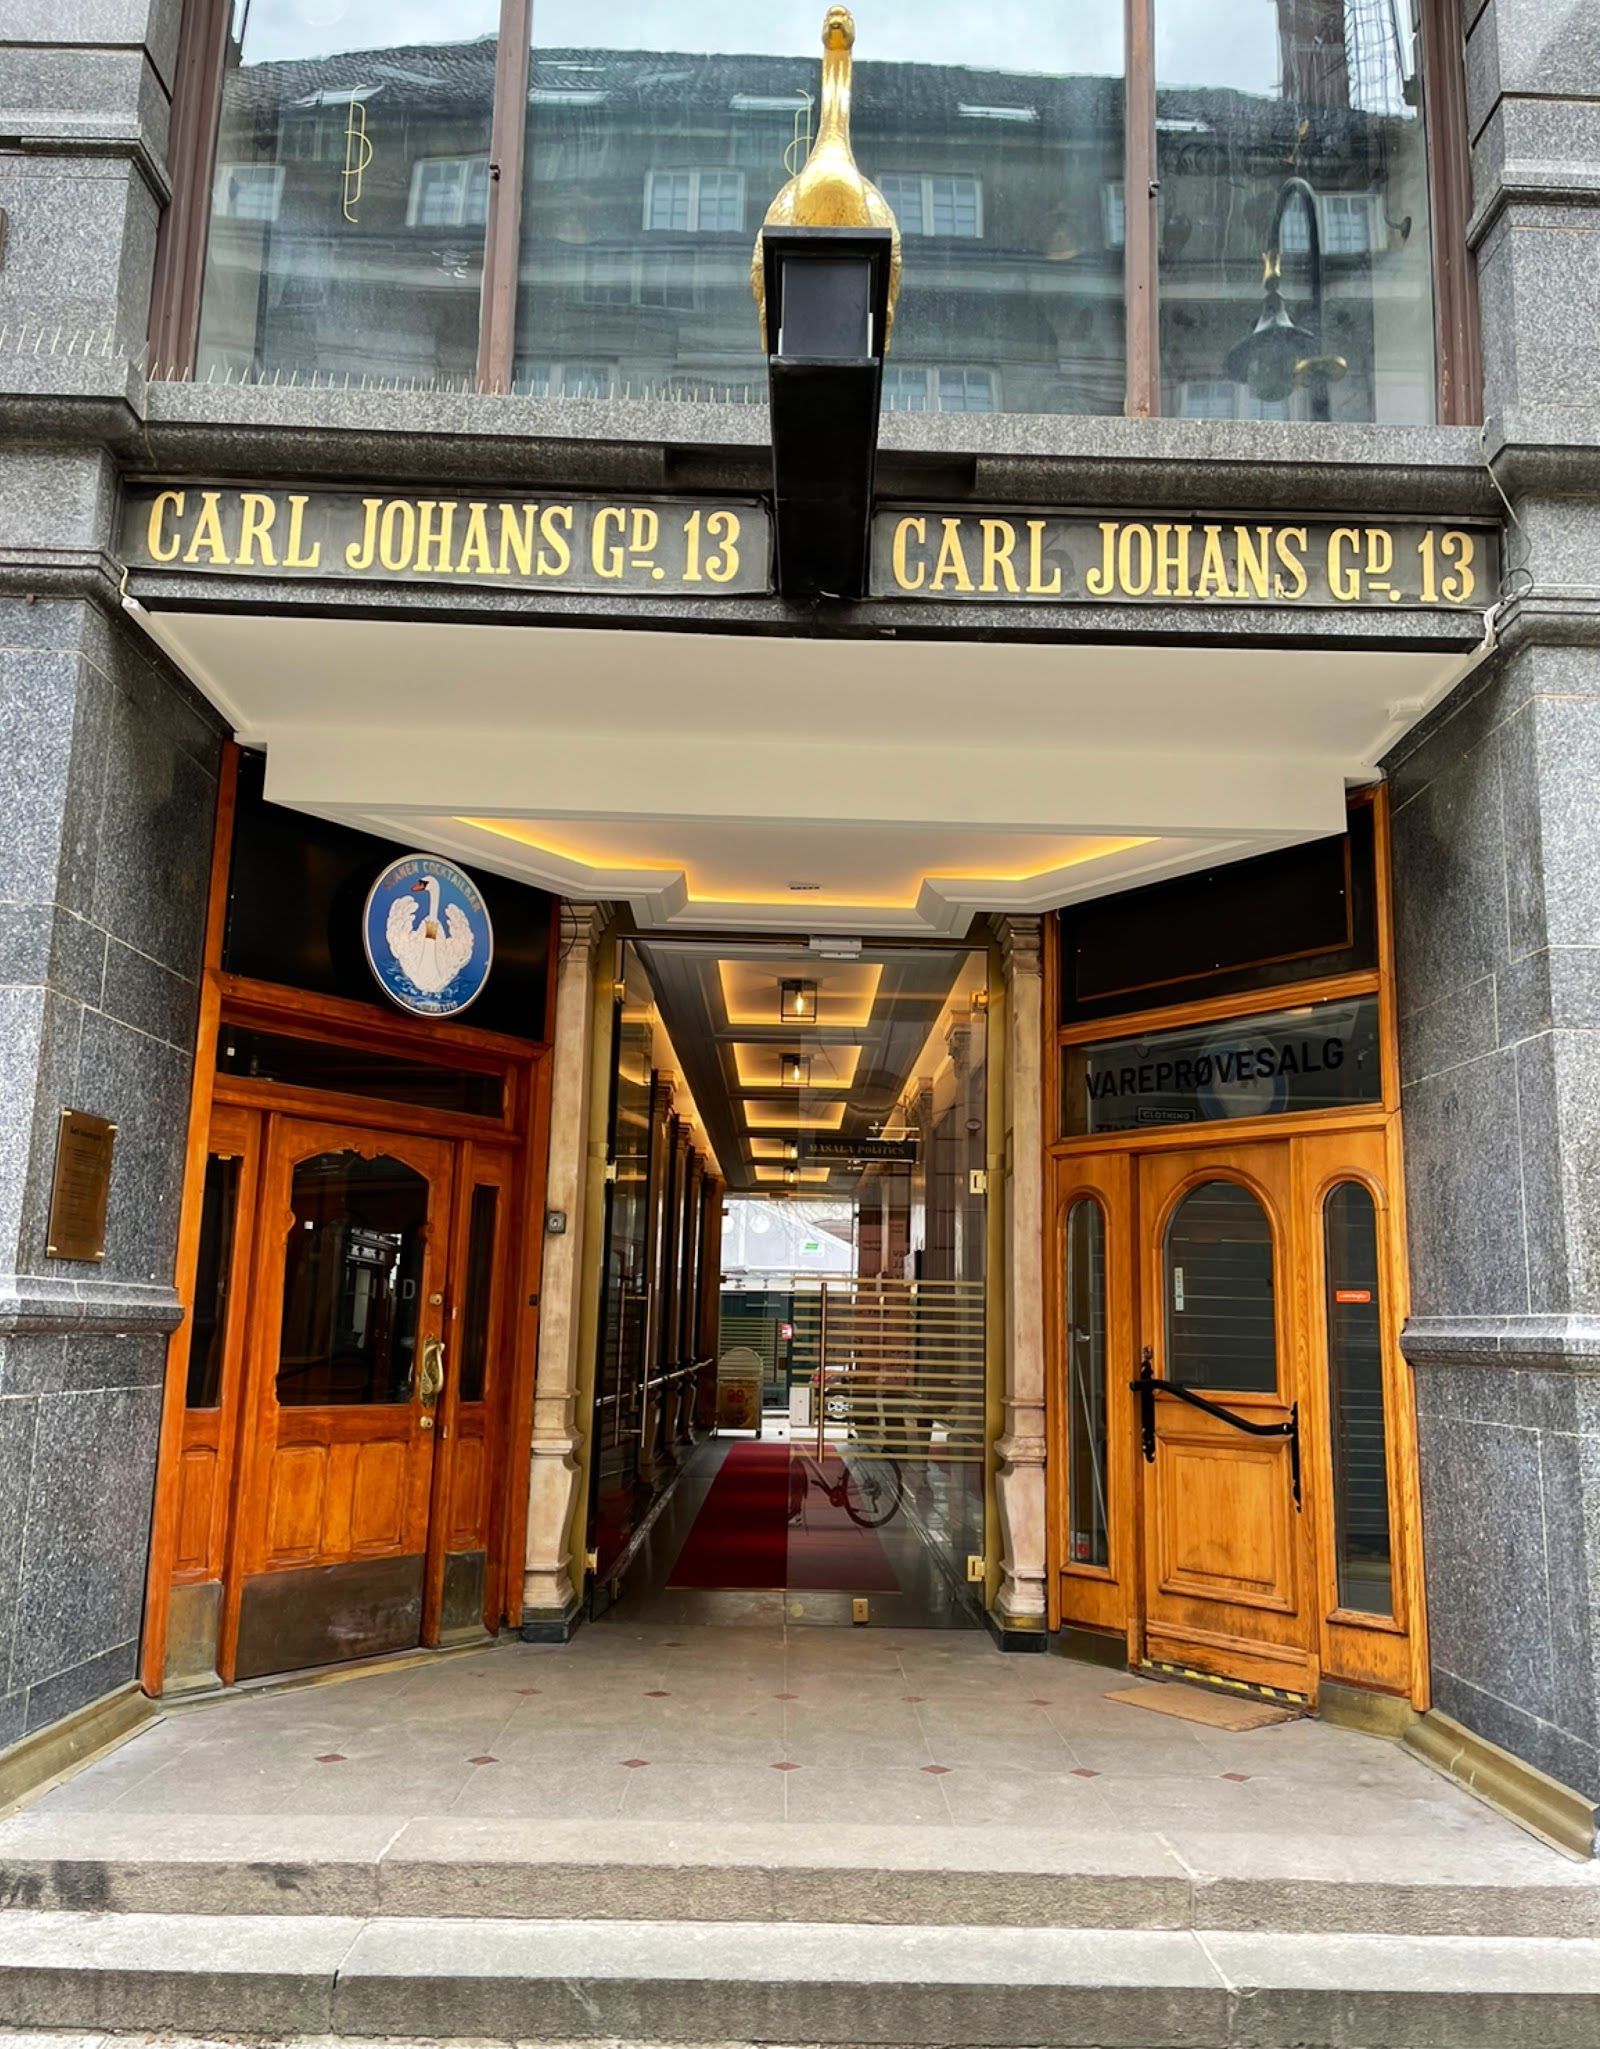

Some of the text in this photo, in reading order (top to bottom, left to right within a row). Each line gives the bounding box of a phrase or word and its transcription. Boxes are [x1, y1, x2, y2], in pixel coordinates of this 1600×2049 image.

[147, 490, 320, 568] CARL
[345, 498, 573, 577] JOHANS
[683, 510, 741, 582] 13
[892, 516, 1061, 595] CARL
[1085, 522, 1308, 599] JOHANS
[1417, 530, 1475, 603] 13
[1085, 1037, 1344, 1100] VAREPRØVESALG
[857, 1144, 905, 1155] POLITICS
